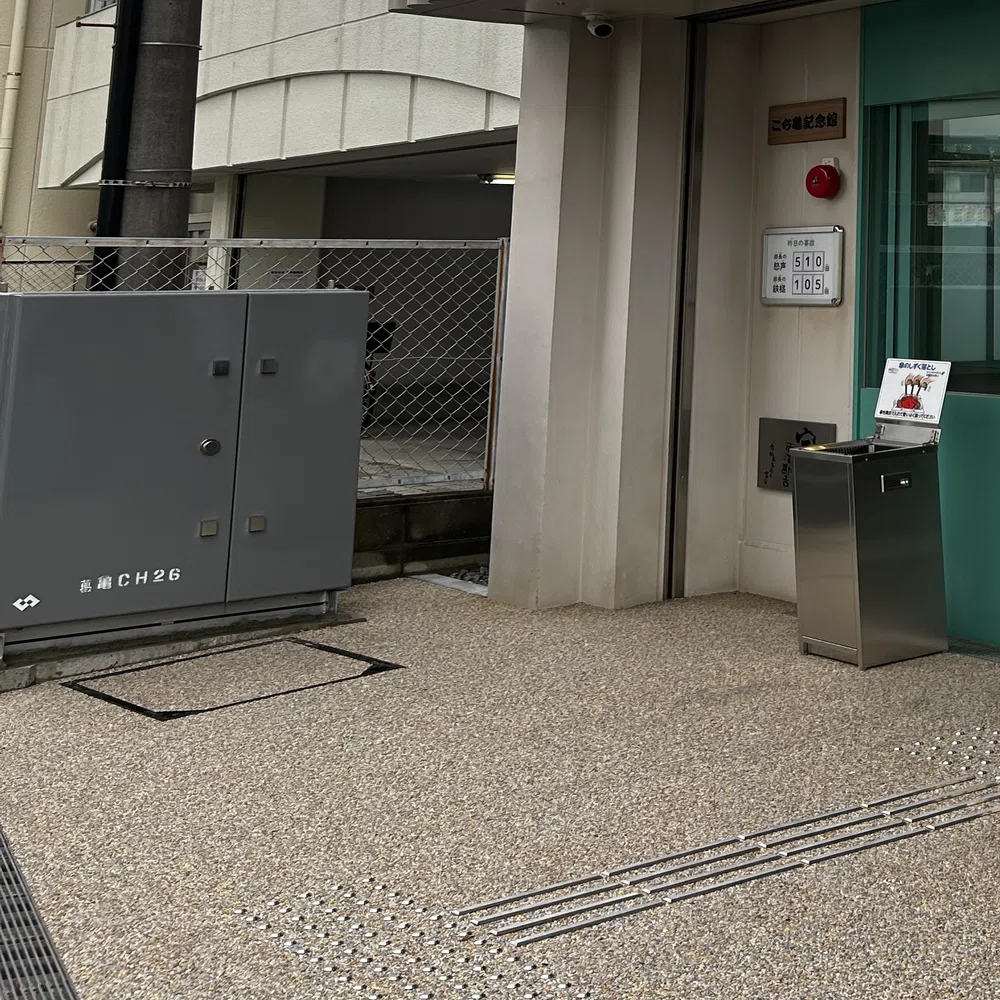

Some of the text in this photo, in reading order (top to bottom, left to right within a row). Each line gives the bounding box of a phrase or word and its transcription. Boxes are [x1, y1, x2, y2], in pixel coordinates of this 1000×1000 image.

[771, 112, 838, 132] こち亀記念館
[794, 256, 822, 267] 510
[794, 279, 821, 290] 105
